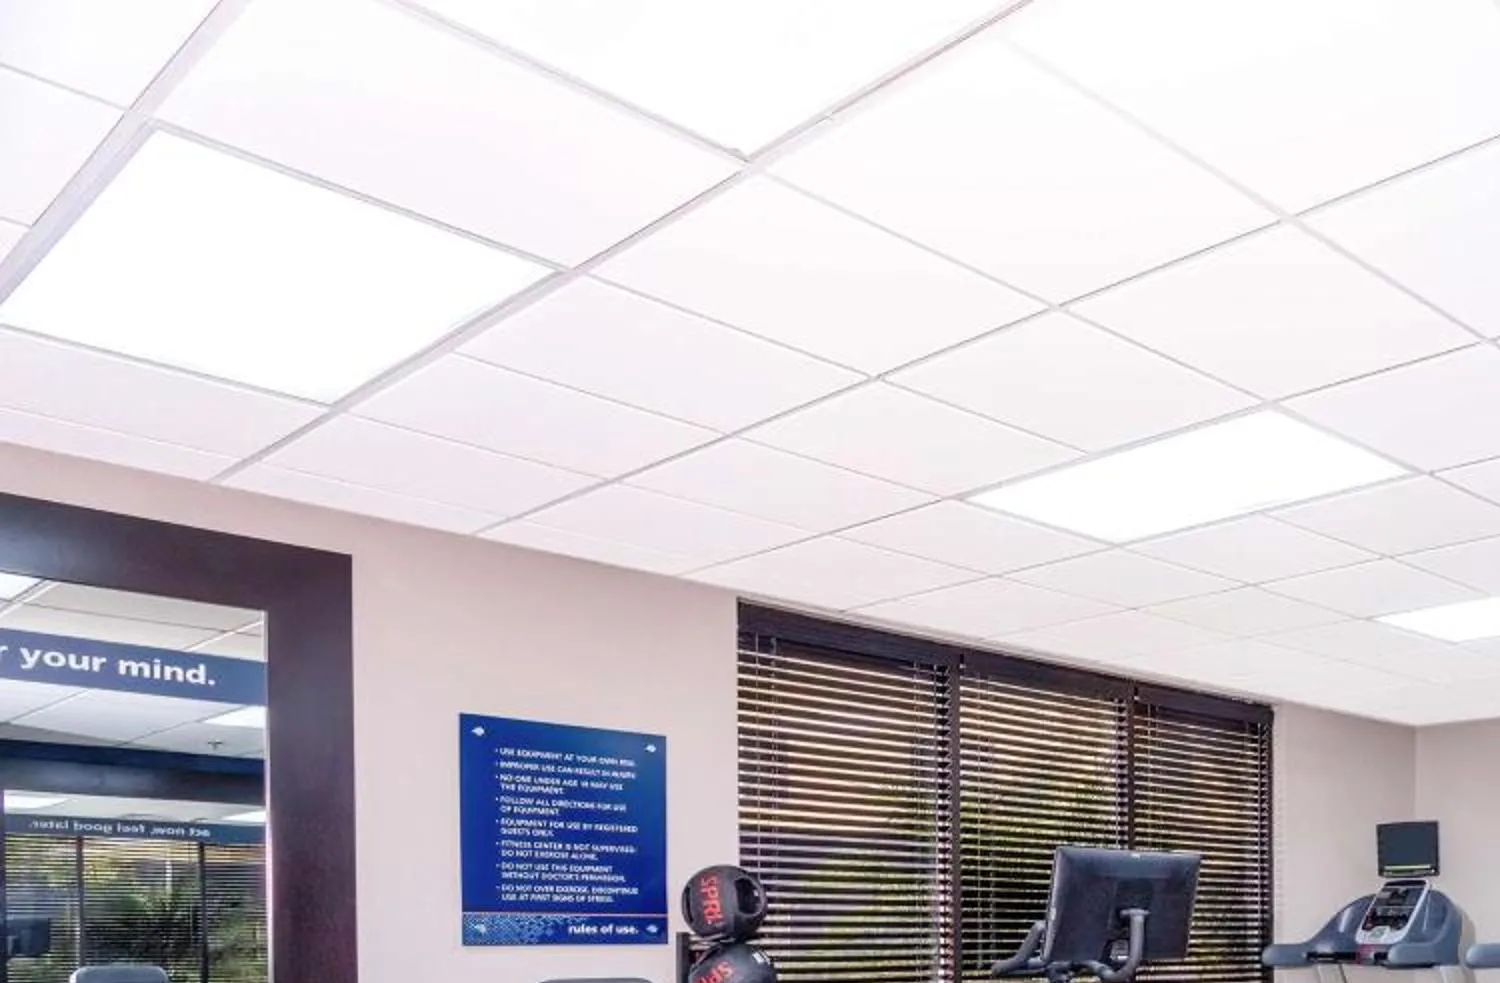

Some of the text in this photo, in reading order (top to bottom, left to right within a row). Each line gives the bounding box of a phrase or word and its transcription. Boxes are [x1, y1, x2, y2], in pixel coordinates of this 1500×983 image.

[20, 646, 107, 673] your
[118, 658, 216, 687] mind.
[501, 849, 514, 857] DO
[516, 849, 532, 858] NOT
[568, 923, 639, 936] rules of use.
